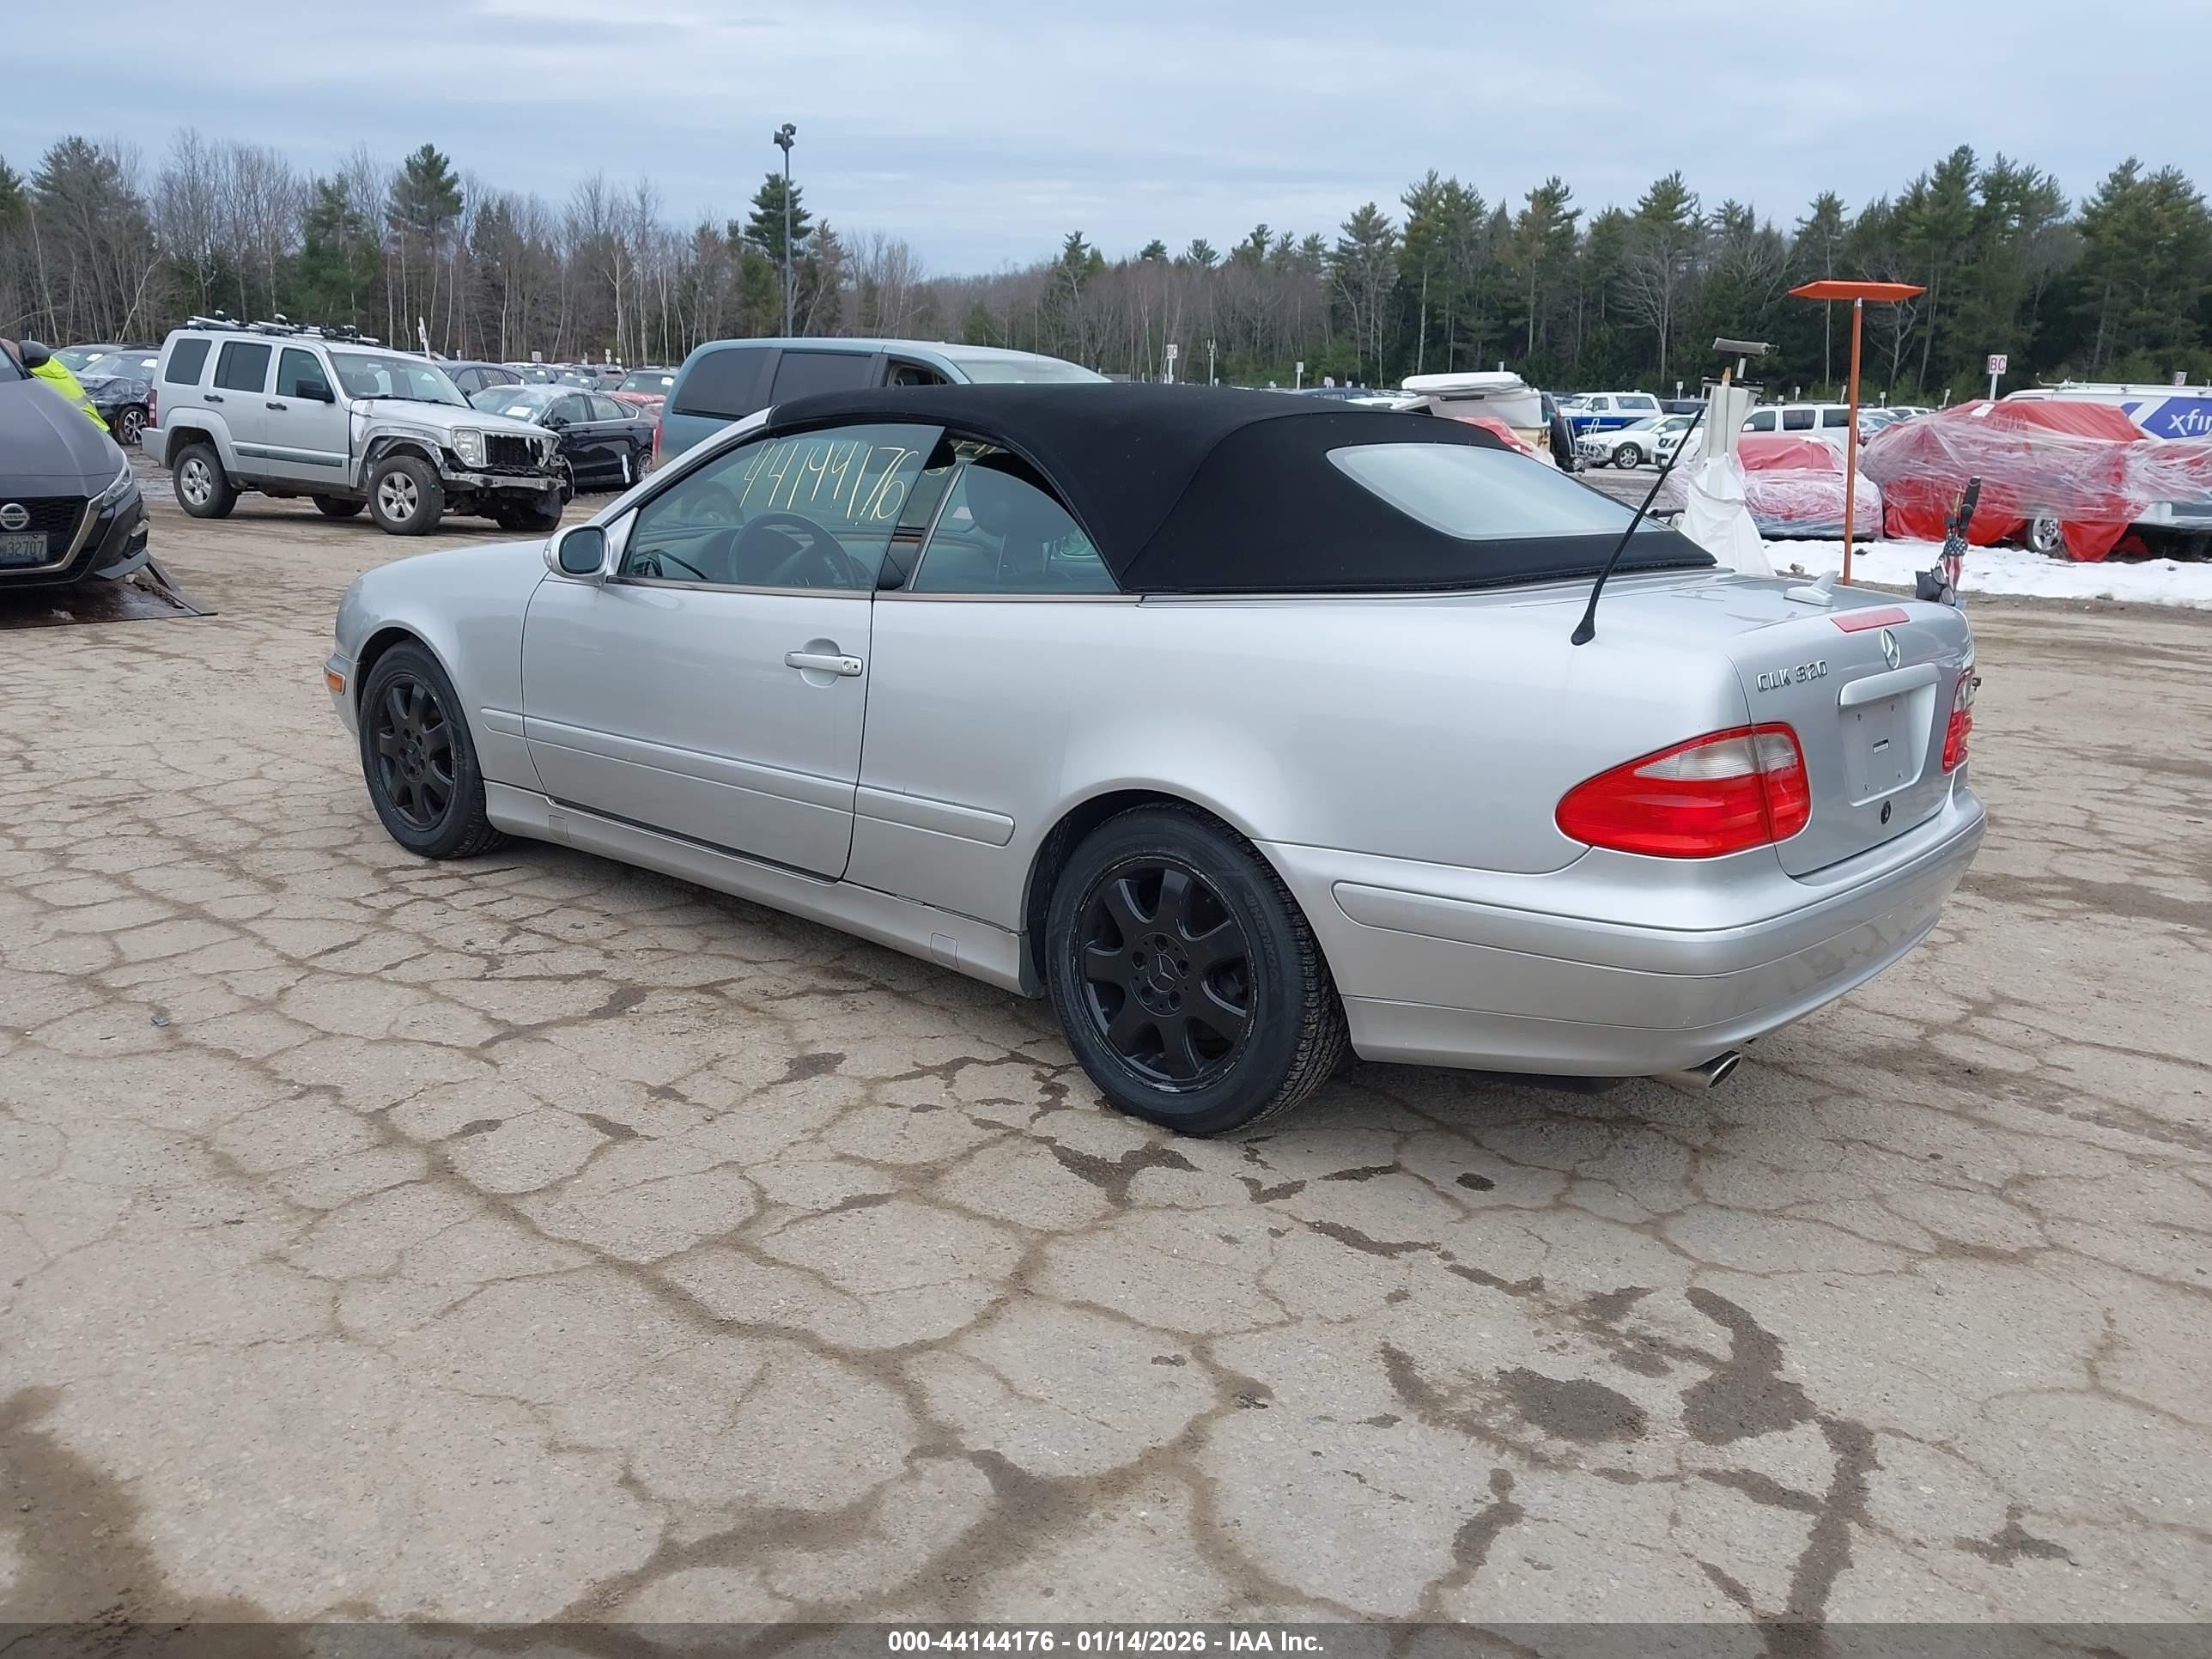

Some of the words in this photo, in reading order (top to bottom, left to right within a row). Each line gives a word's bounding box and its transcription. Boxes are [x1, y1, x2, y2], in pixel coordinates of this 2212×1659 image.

[1990, 357, 2006, 371] BC
[1756, 668, 1792, 692] CLK
[1795, 659, 1828, 684] 320
